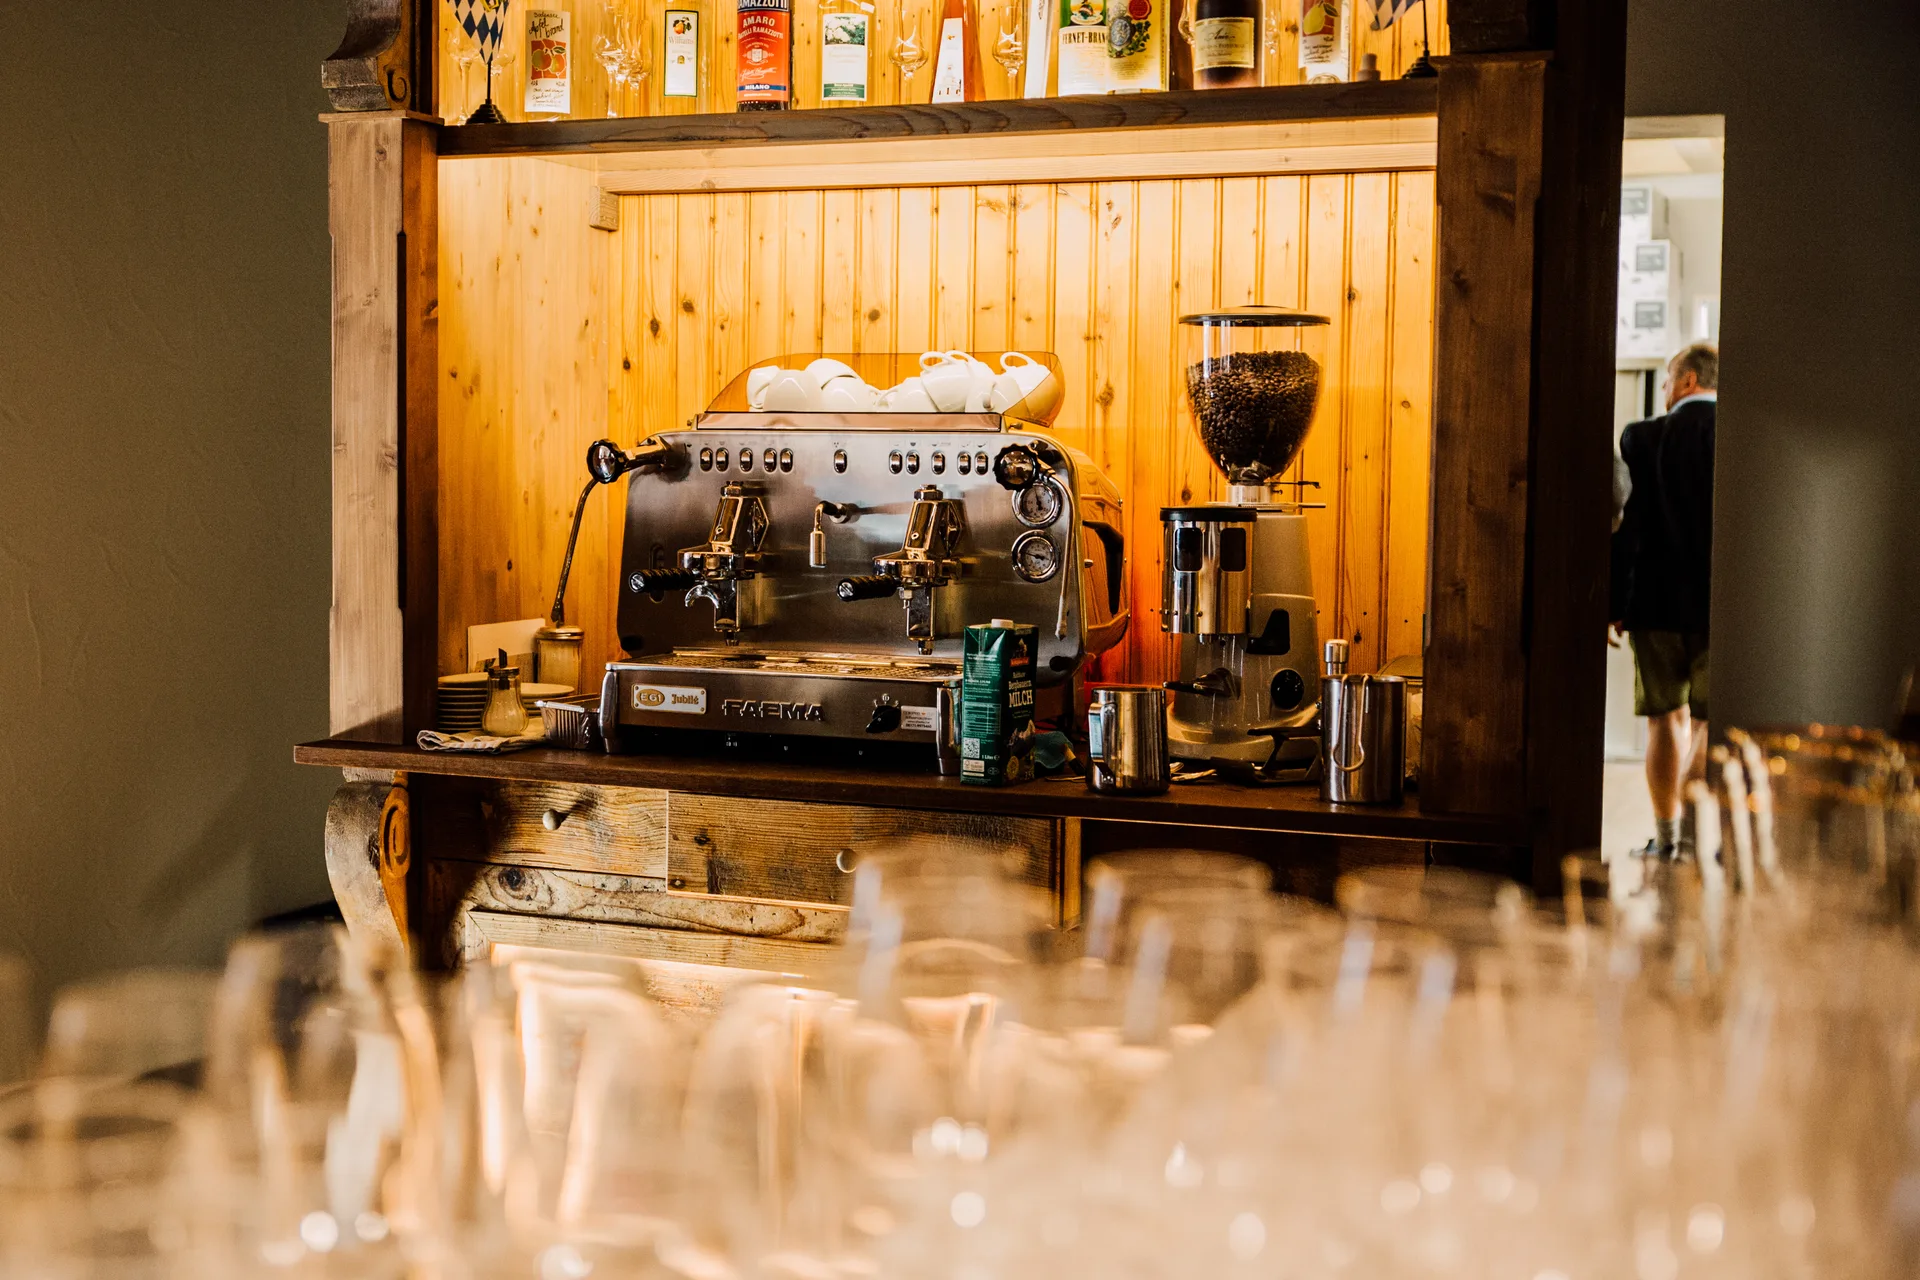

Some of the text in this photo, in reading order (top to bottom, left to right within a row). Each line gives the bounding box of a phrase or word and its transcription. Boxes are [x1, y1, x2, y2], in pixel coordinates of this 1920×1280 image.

[742, 15, 776, 28] AMARO
[671, 693, 699, 705] Jubilé
[1008, 689, 1033, 708] MILCH
[721, 699, 825, 721] FAEMA
